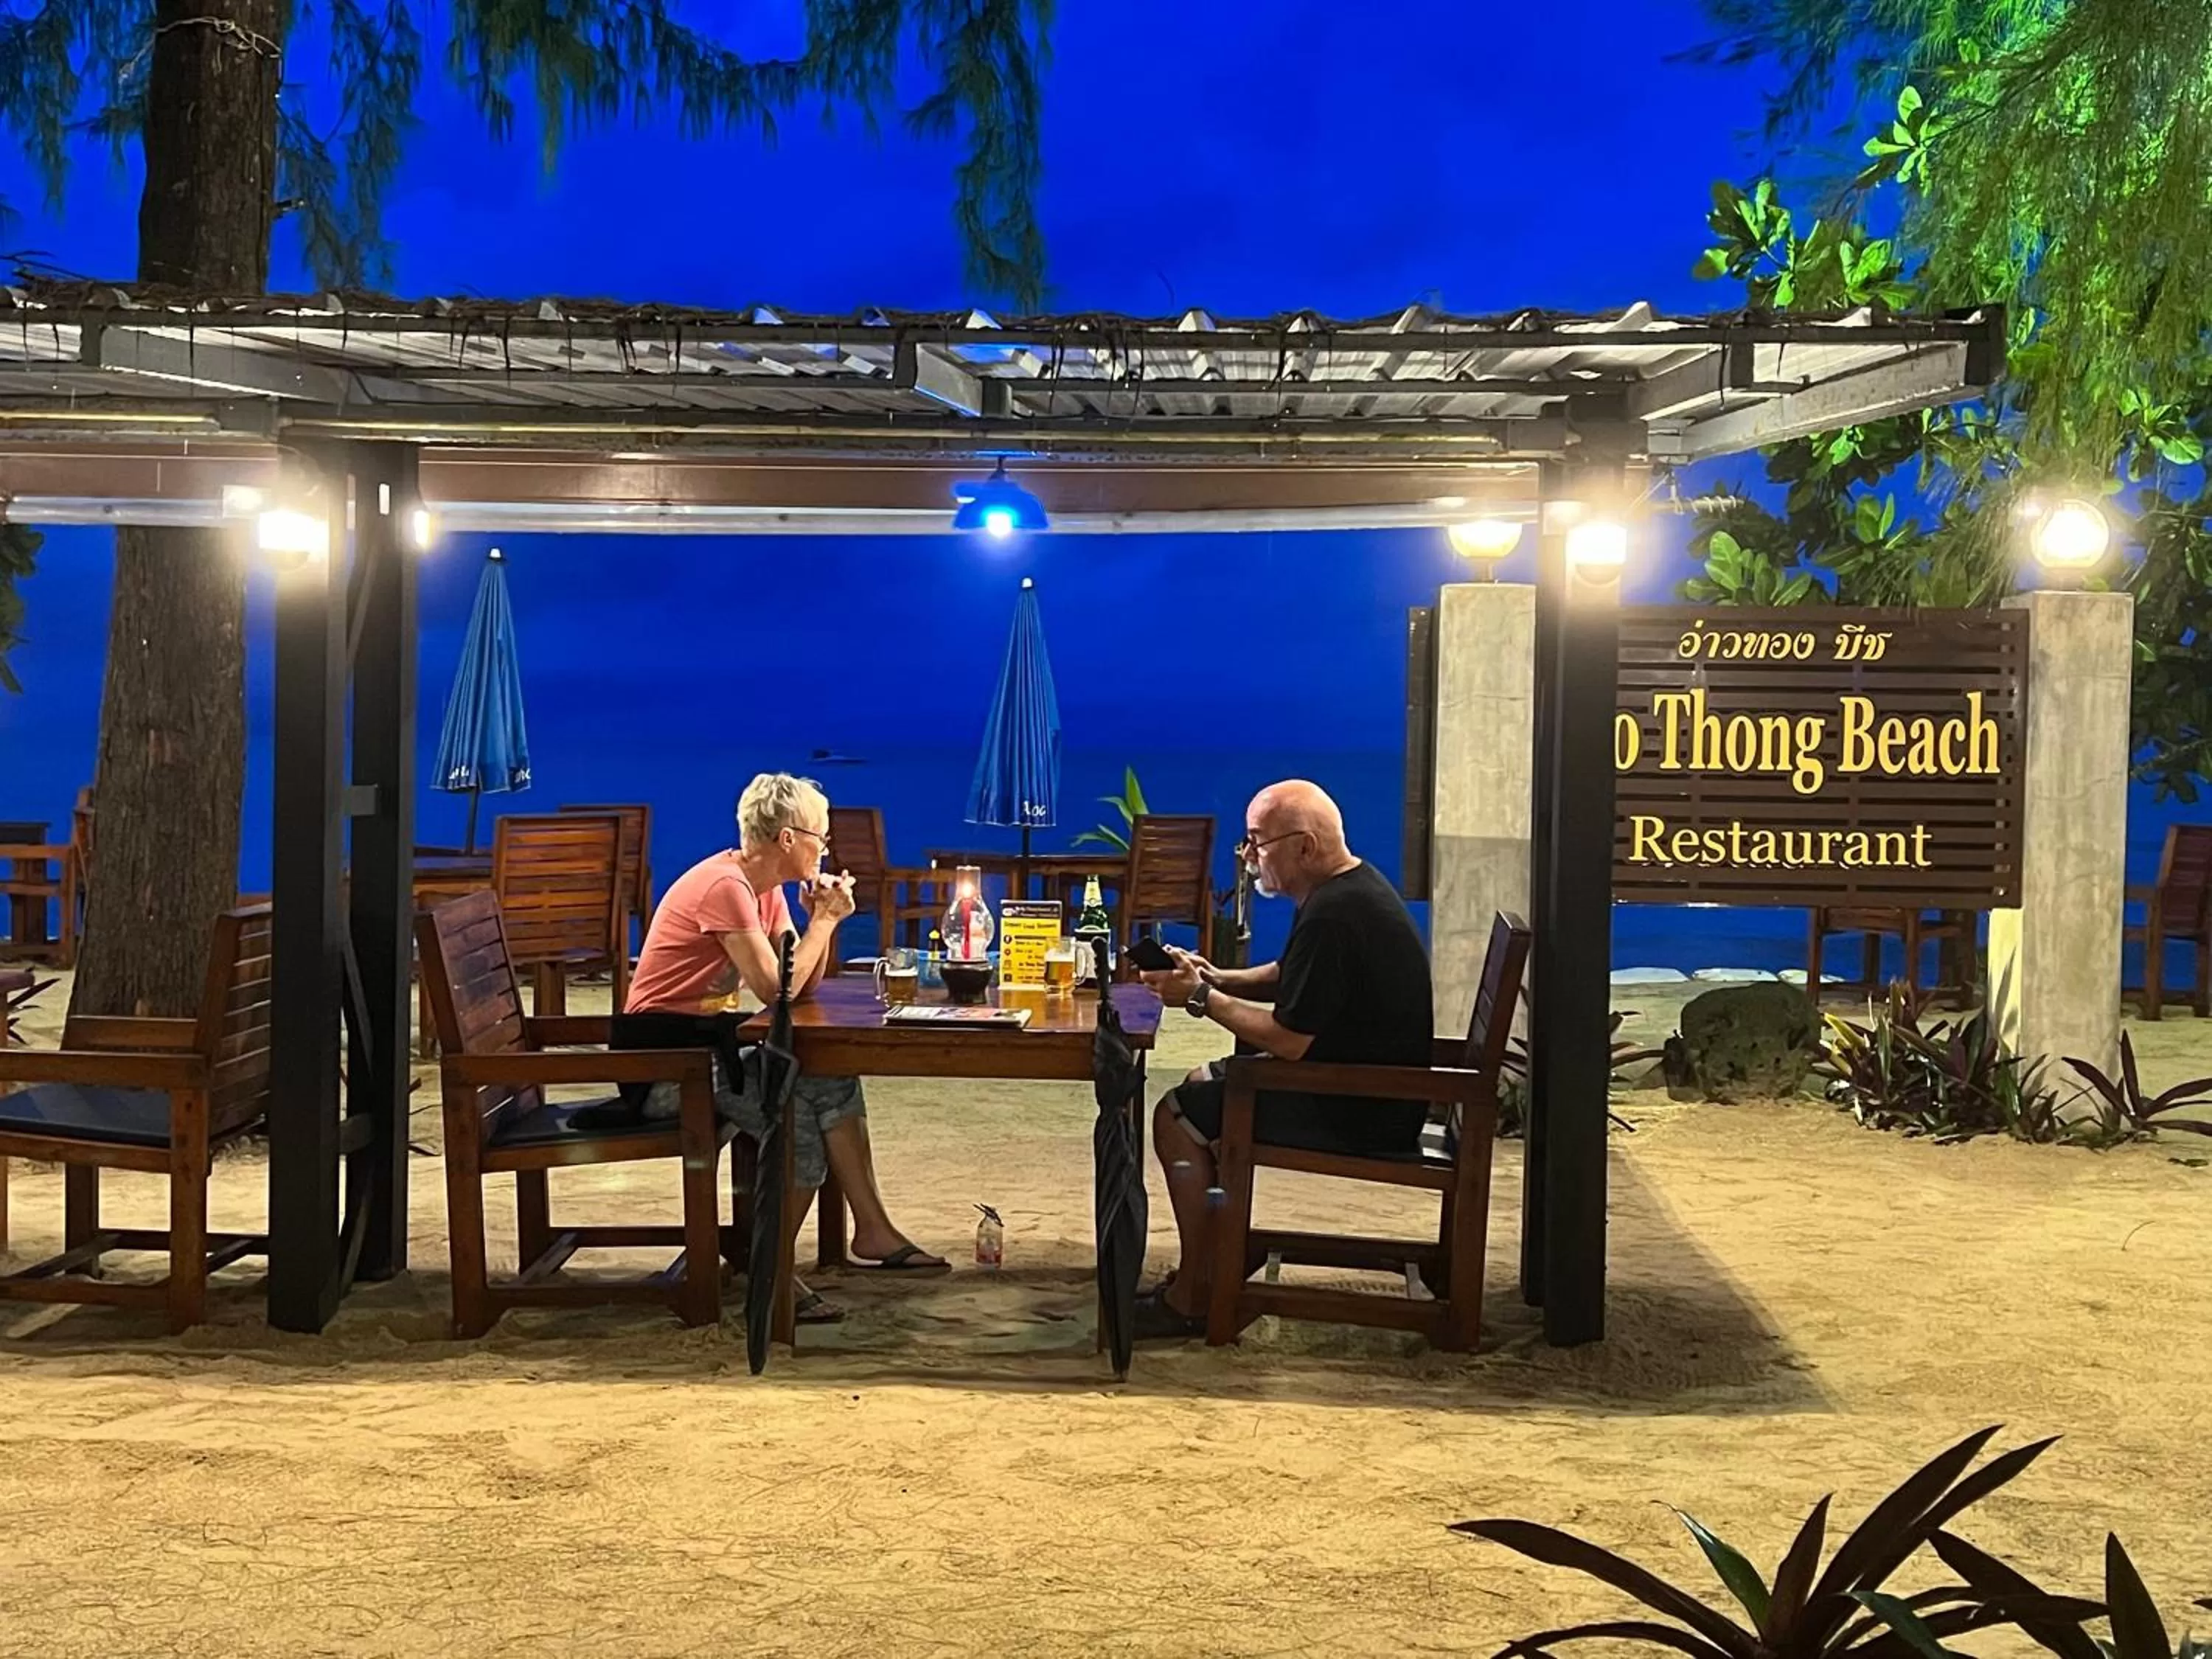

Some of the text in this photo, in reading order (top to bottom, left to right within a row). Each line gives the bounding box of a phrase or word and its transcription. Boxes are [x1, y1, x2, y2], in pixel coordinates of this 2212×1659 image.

[1678, 619, 1893, 660] อ่าวทอง บีช
[1615, 688, 2000, 794] o Thong Beach
[1628, 815, 1933, 867] Restaurant
